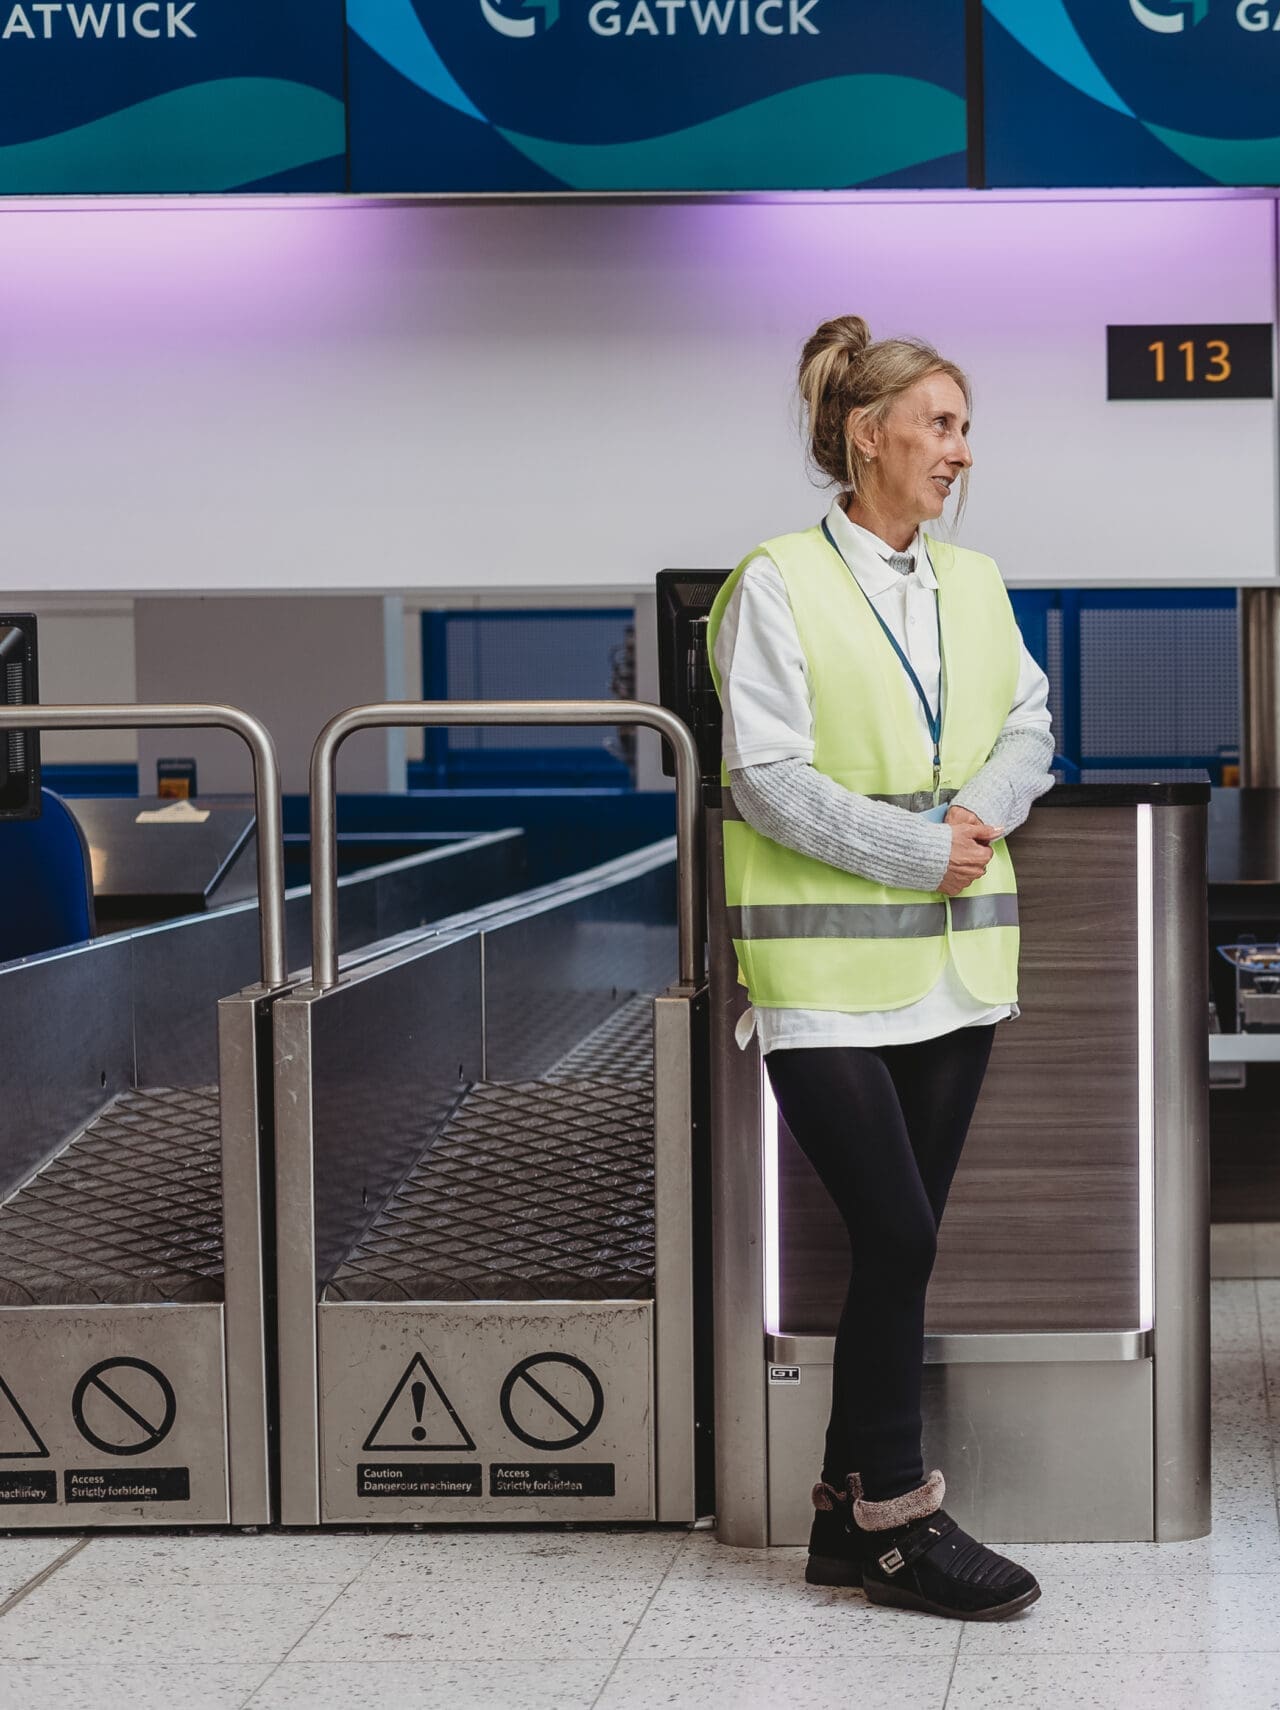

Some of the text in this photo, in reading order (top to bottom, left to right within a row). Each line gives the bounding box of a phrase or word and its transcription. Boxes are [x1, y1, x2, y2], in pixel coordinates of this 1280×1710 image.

[588, 0, 821, 36] GATWICK
[1148, 340, 1232, 383] 113
[772, 1369, 797, 1377] GT
[364, 1468, 403, 1478] Caution
[497, 1468, 530, 1478] Access
[71, 1475, 104, 1485] Access
[364, 1480, 473, 1492] Dangerous machinery
[497, 1480, 583, 1492] Strictly forbidden
[71, 1485, 158, 1498] Strictly forbidden
